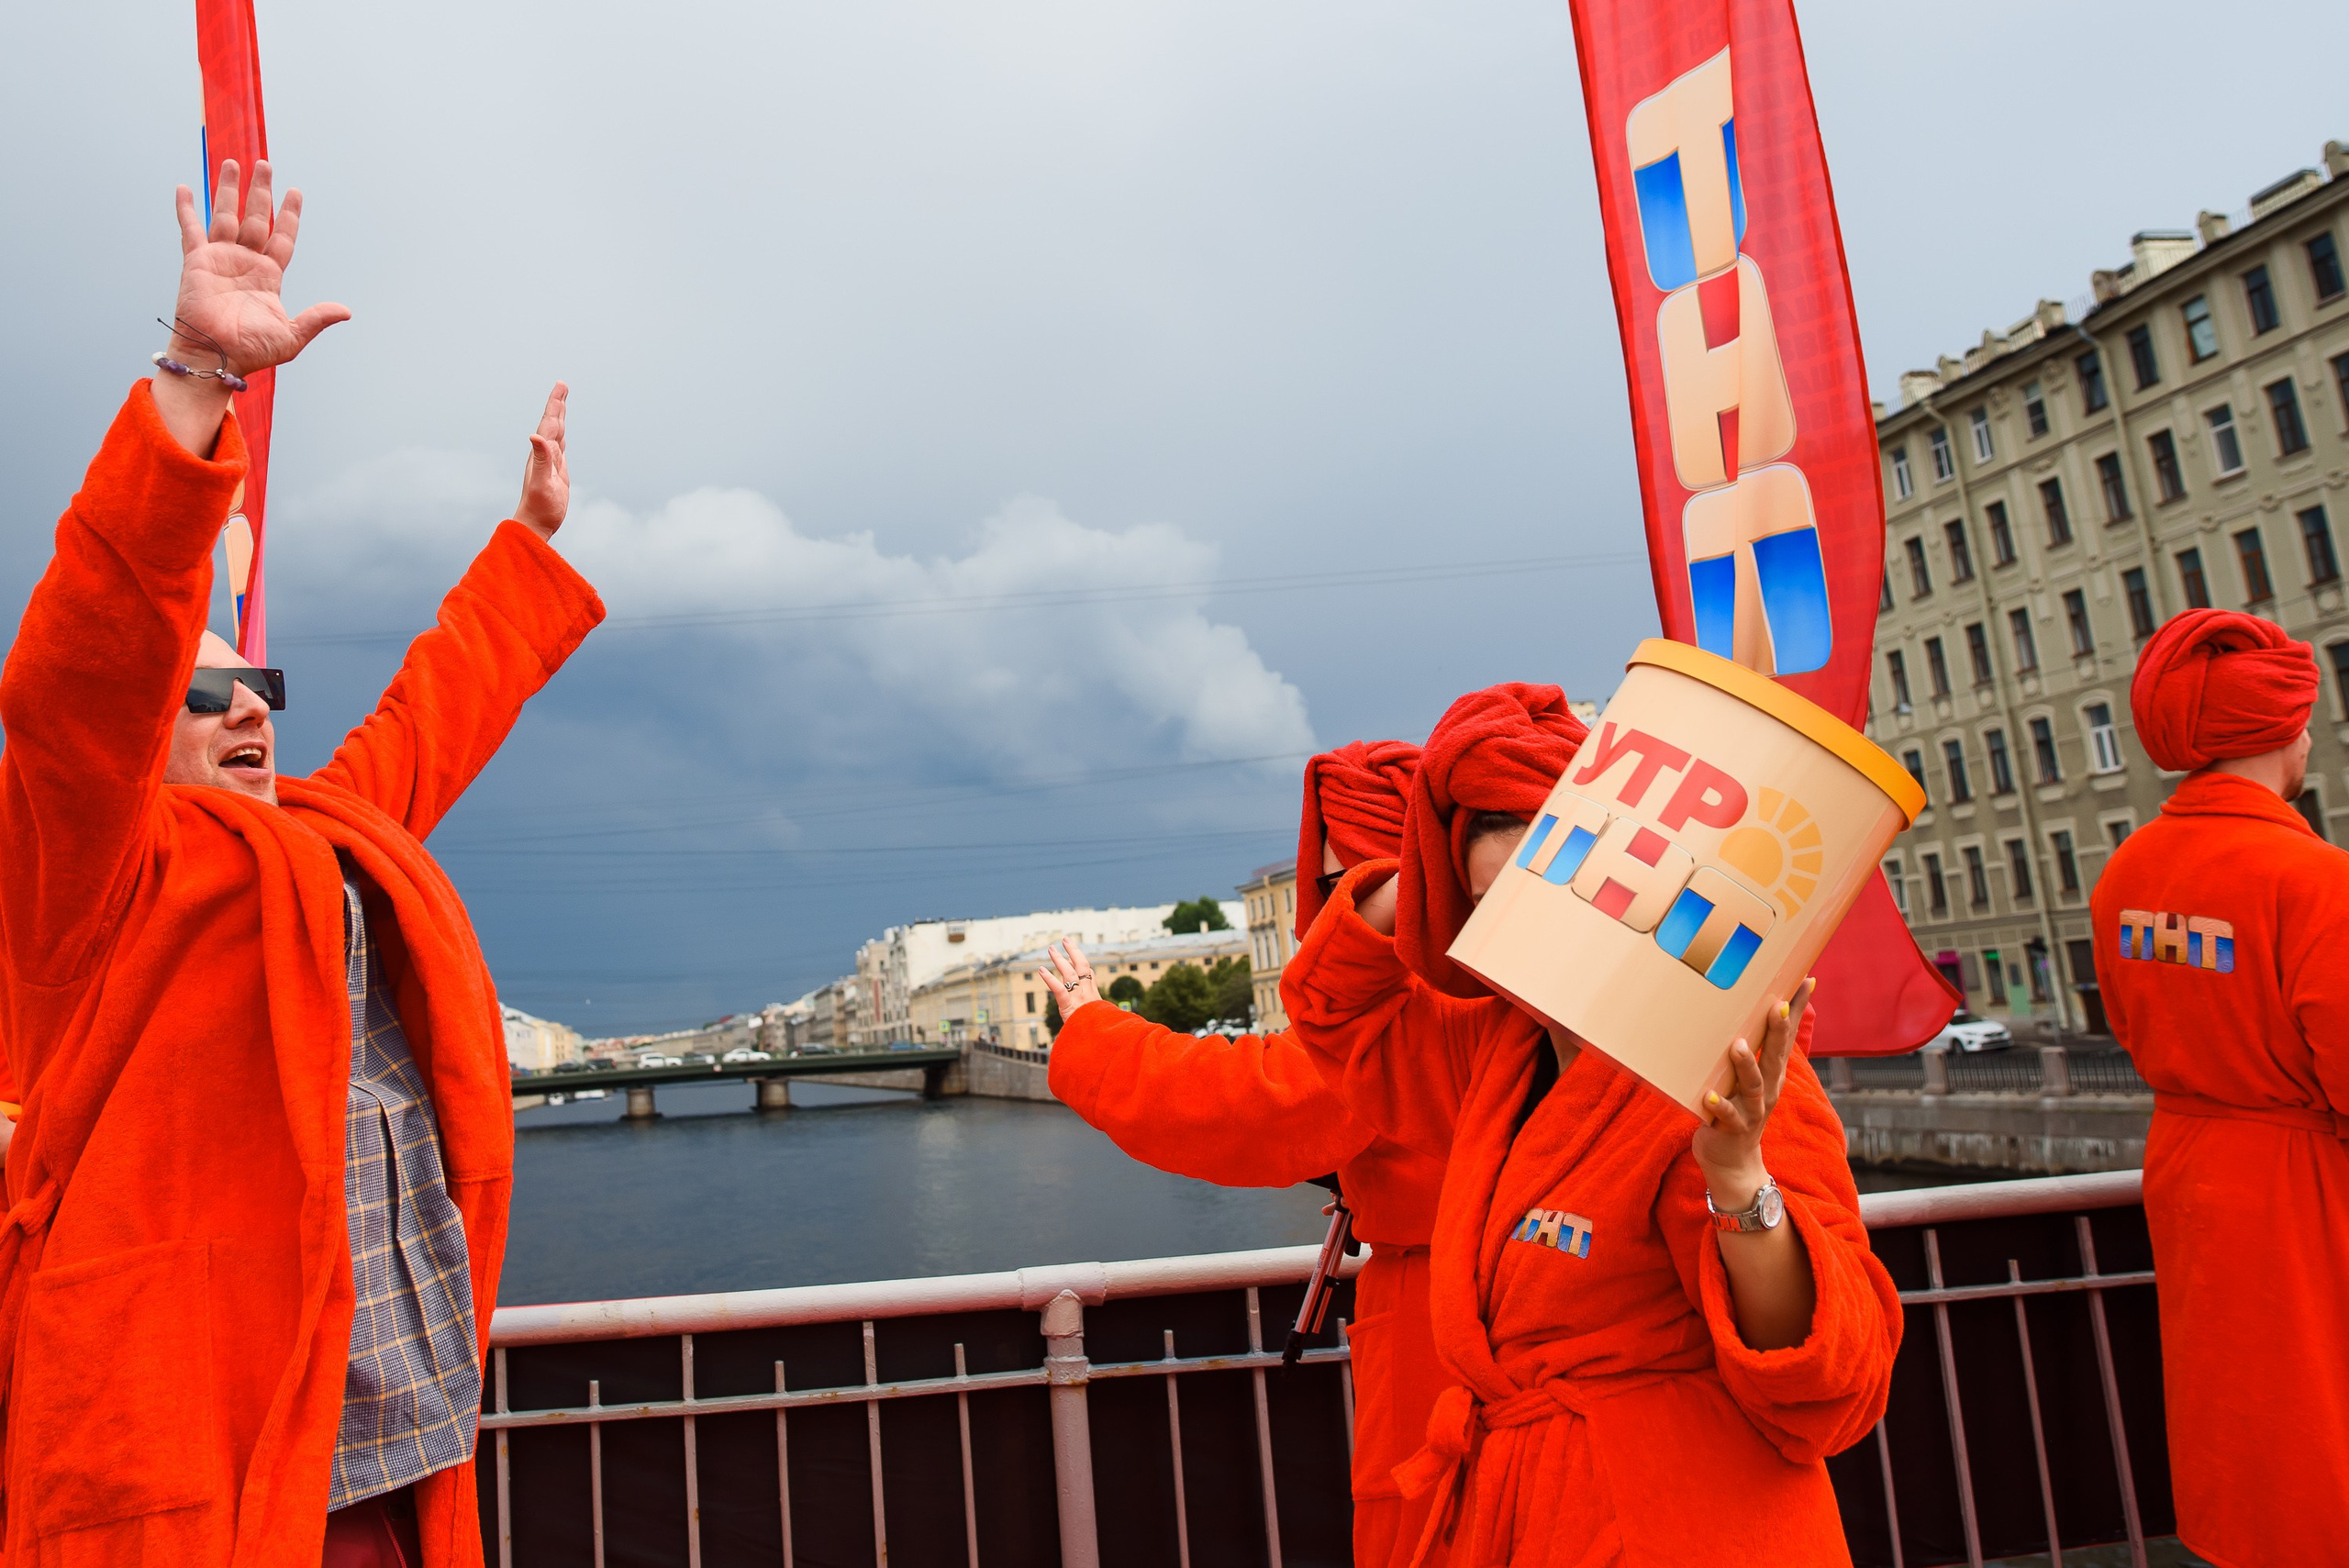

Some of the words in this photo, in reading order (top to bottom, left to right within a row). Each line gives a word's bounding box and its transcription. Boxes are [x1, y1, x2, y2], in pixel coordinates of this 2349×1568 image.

[1625, 44, 1833, 677] ТНТ
[1515, 790, 1777, 991] ТНТ
[2119, 907, 2234, 974] ТНТ
[1510, 1207, 1594, 1260] ТНТ
